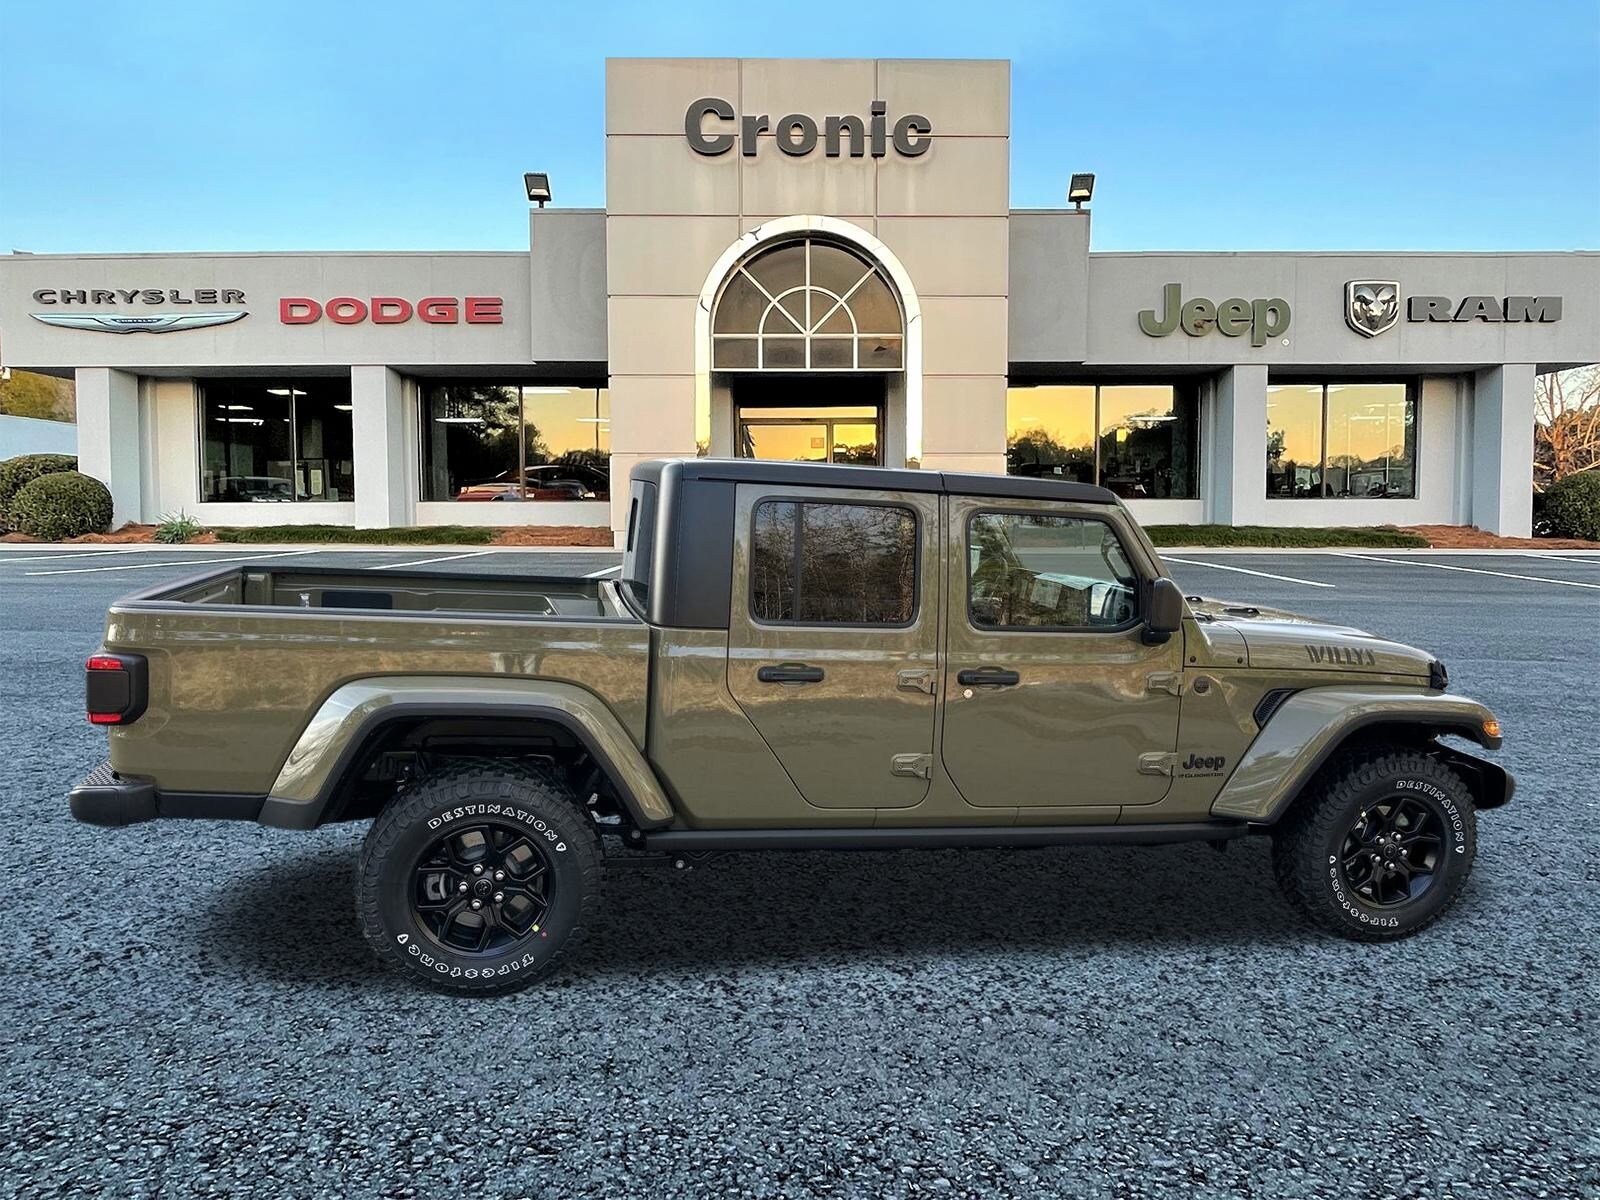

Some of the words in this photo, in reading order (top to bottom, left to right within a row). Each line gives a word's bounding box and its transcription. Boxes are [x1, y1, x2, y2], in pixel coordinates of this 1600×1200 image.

[685, 97, 932, 158] Cronic
[32, 288, 247, 305] CHRYSLER
[279, 297, 504, 325] DODGE
[1407, 296, 1563, 323] RAM
[1138, 283, 1291, 347] Jeep
[1304, 644, 1376, 666] WILLYS
[1182, 753, 1226, 771] Jeep
[427, 804, 558, 842] DESTINATION
[1396, 780, 1465, 842] DESTINATION
[408, 944, 534, 979] Firestone
